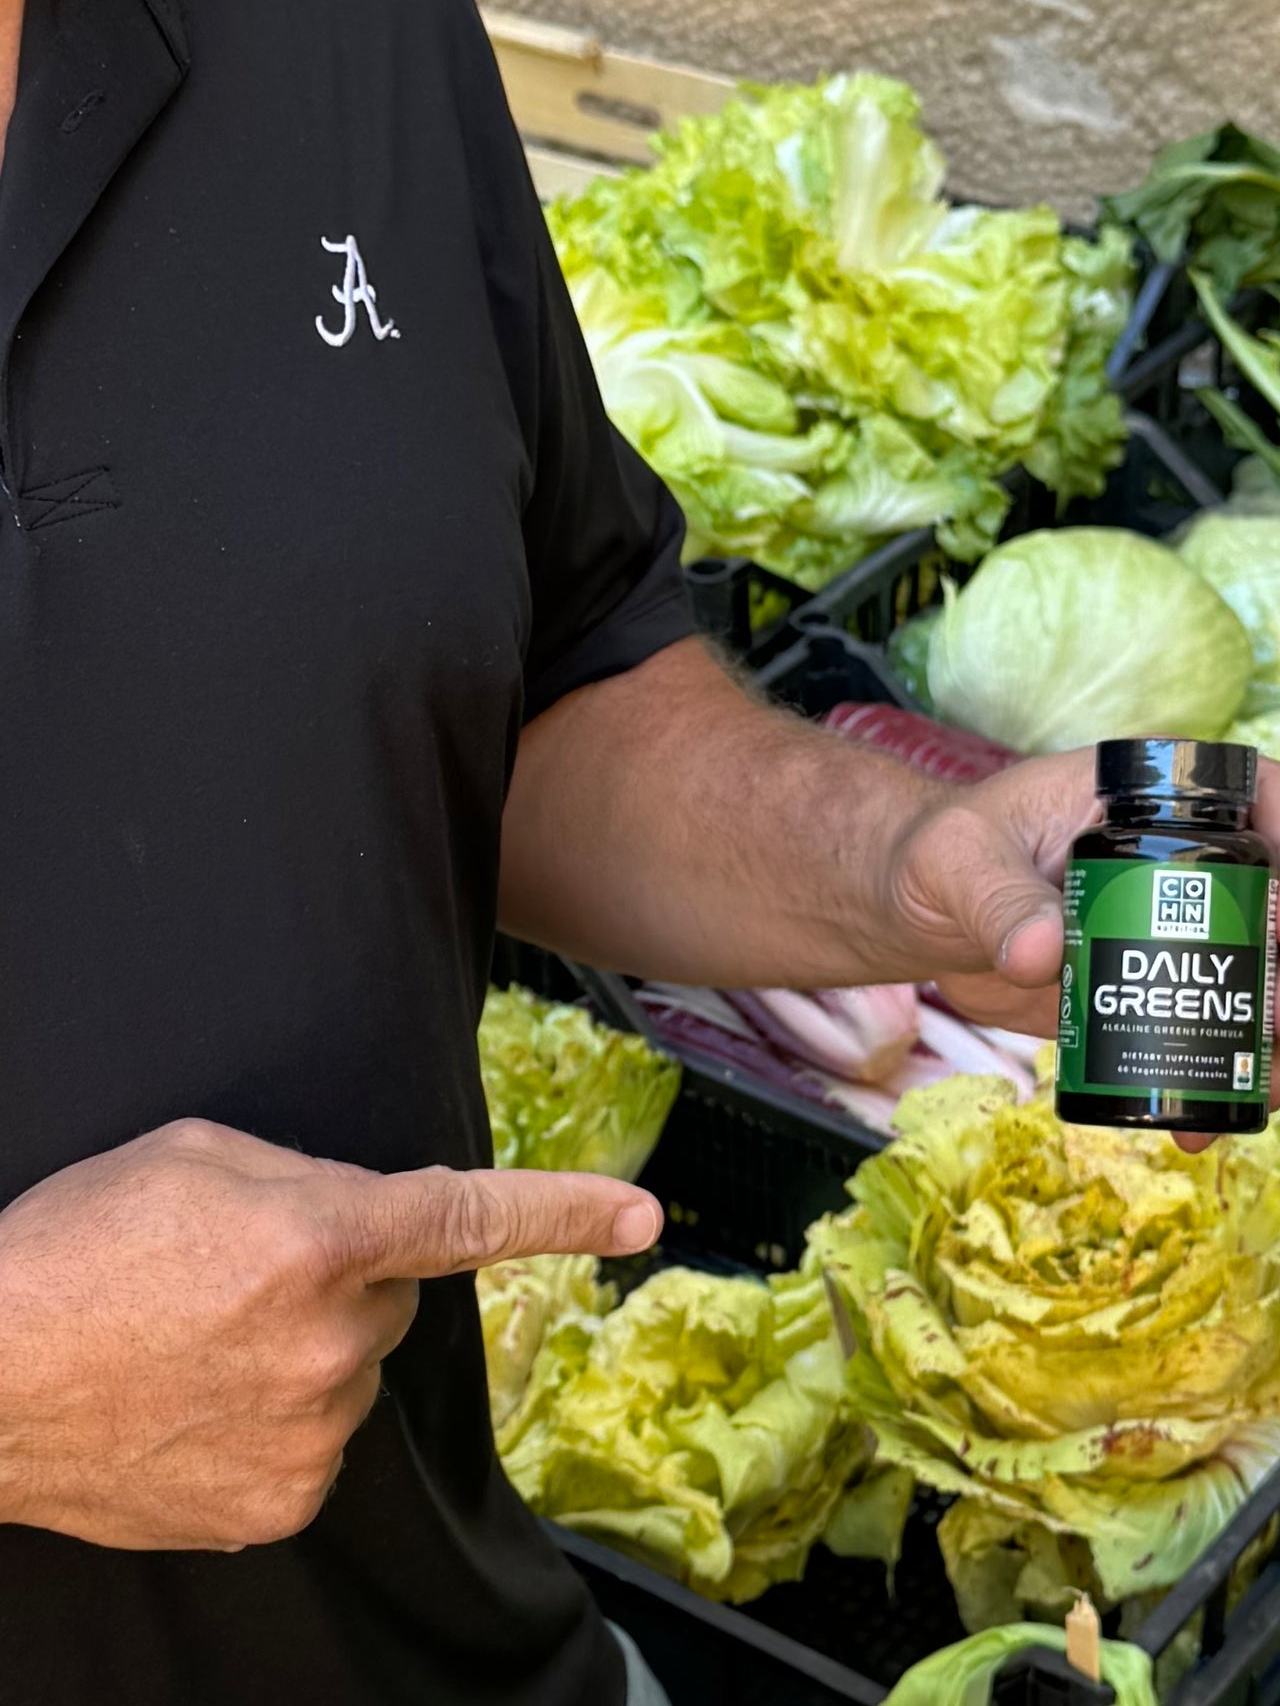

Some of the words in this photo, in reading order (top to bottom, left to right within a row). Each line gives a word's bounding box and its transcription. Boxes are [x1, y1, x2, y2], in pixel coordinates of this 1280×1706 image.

[315, 234, 395, 347] A
[1121, 949, 1234, 985] DAILY
[1094, 984, 1253, 1023] GREENS
[1101, 1022, 1150, 1034] ALKALINE
[1154, 1024, 1196, 1036] GREENS
[1200, 1027, 1244, 1039] FORMULA
[1122, 1051, 1161, 1062] DIETARY
[1166, 1054, 1225, 1065] SUPPLEMENT
[1132, 1066, 1184, 1077] Vegetarian
[1188, 1069, 1228, 1080] Capsules
